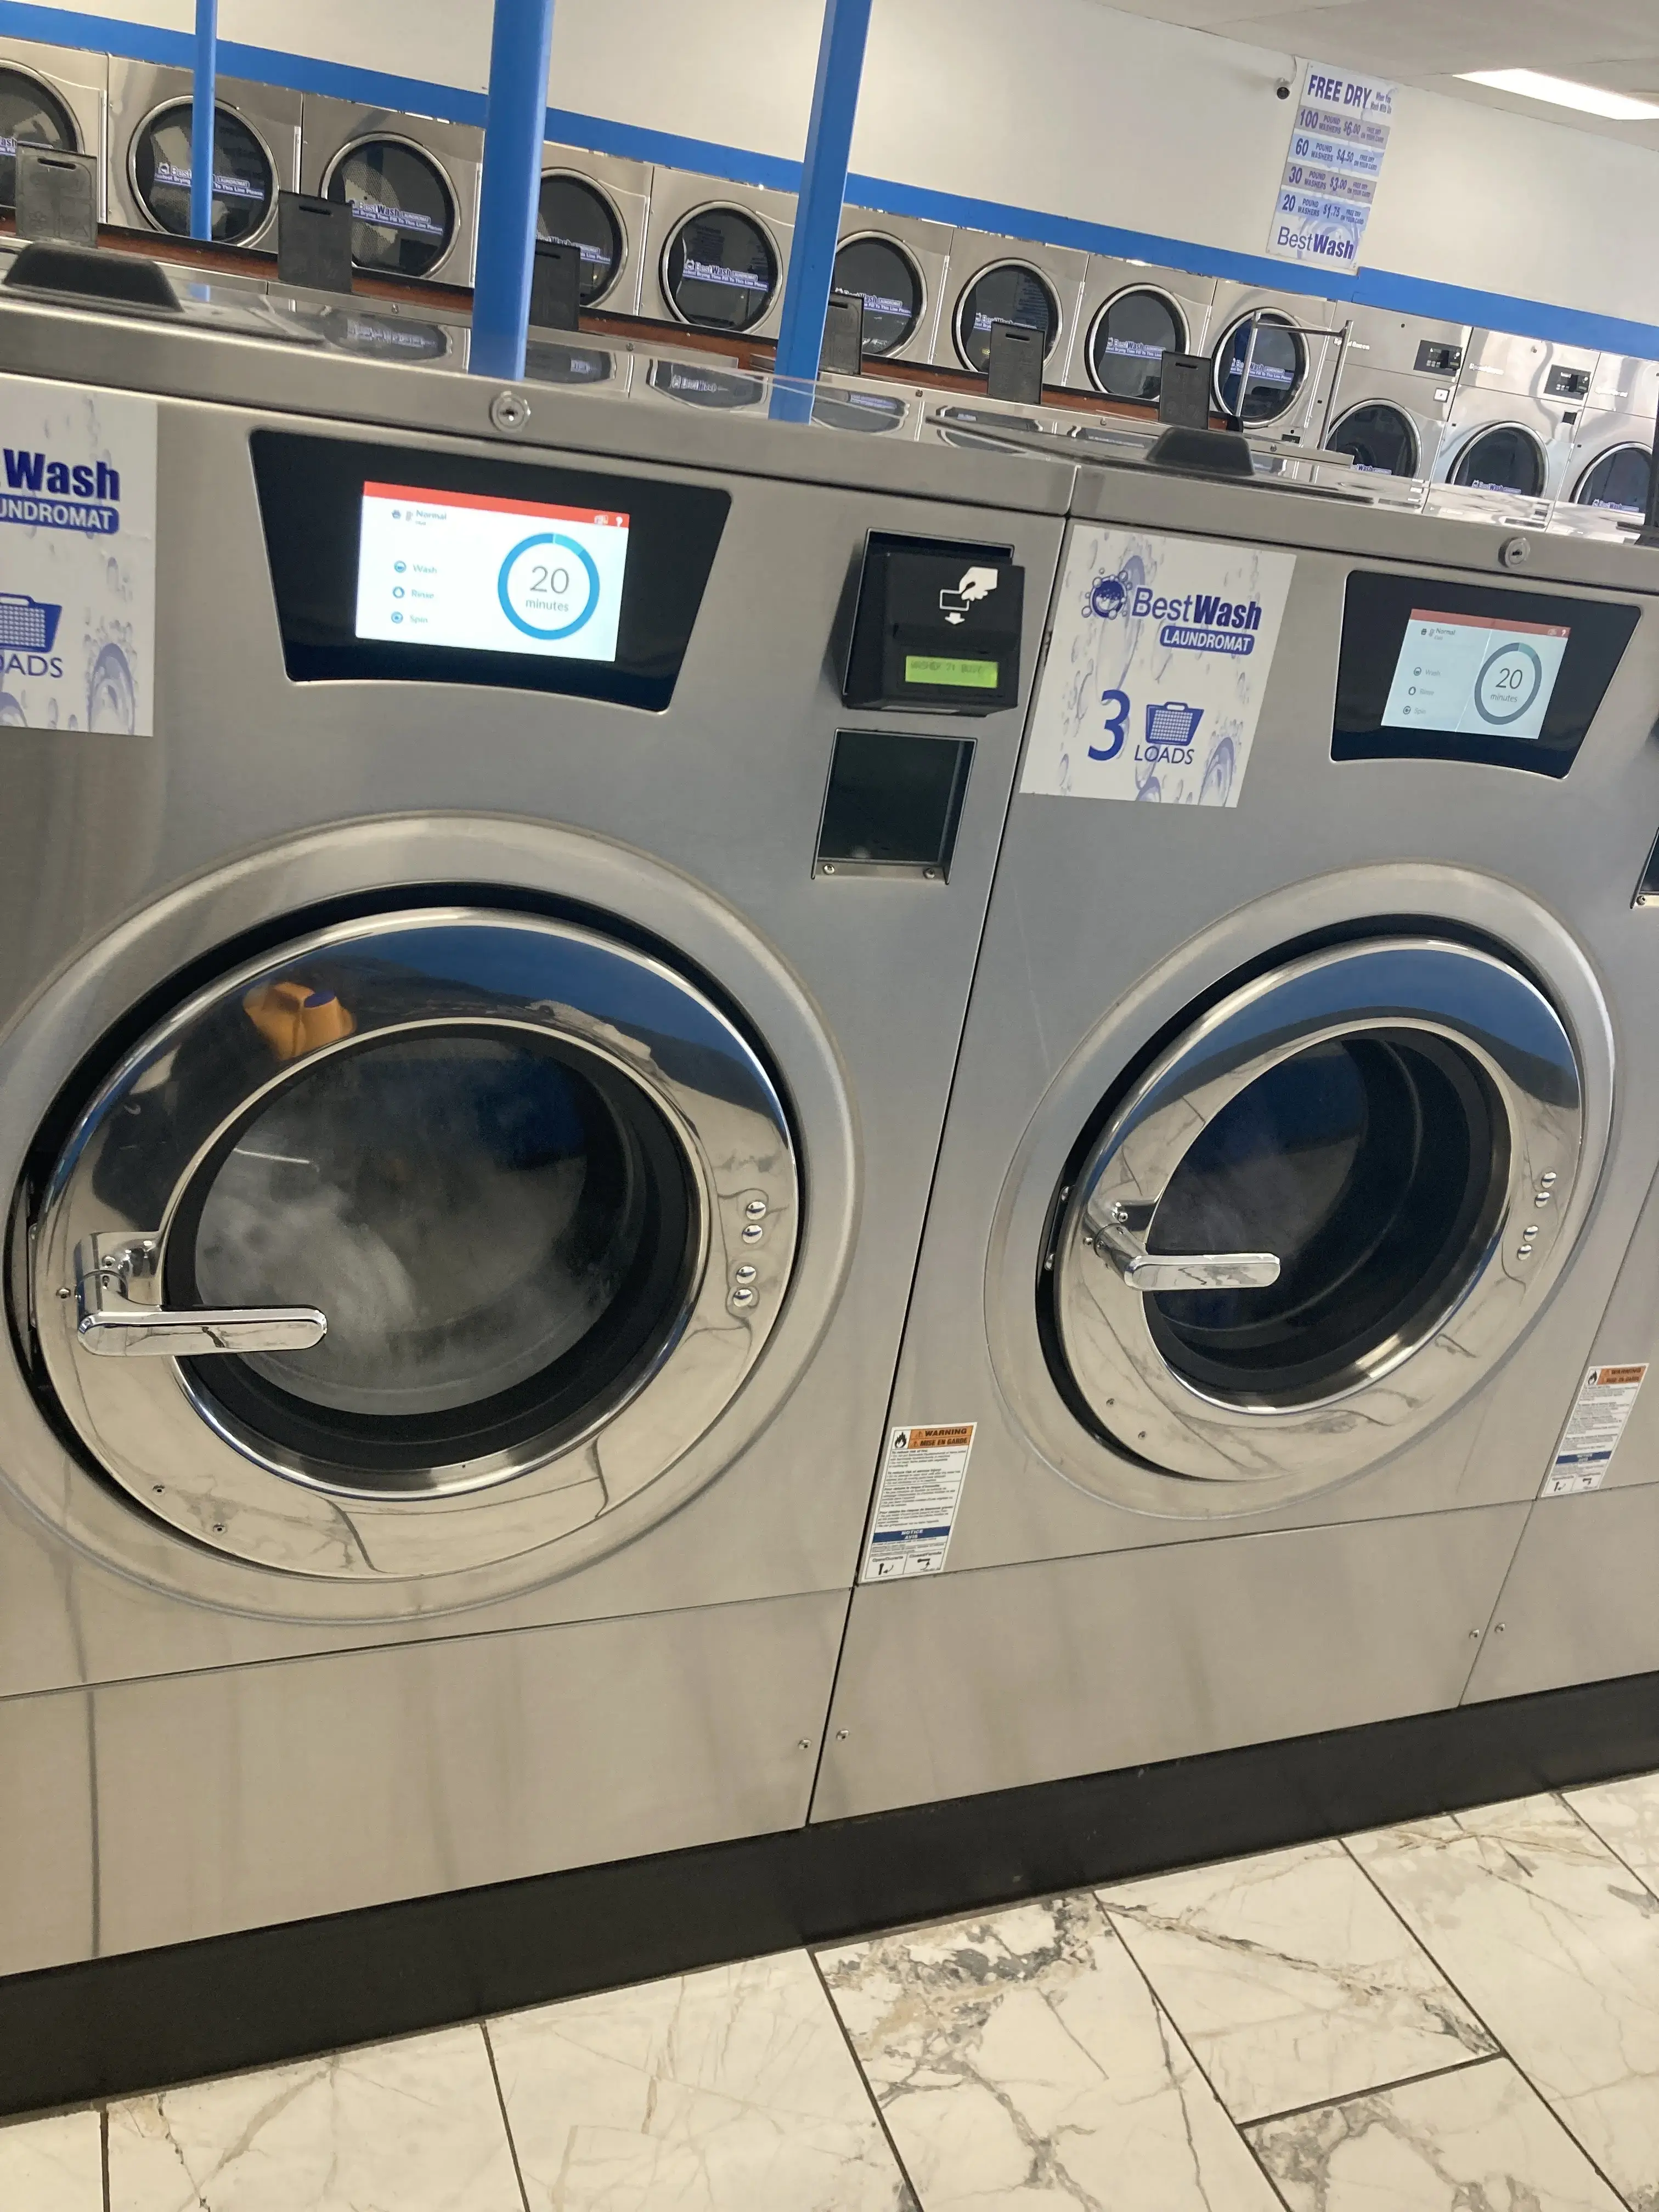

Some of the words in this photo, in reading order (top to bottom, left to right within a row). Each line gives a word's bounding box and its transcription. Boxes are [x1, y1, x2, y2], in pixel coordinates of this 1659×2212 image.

[1307, 75, 1343, 102] FREE
[1344, 84, 1372, 109] DRY
[1300, 109, 1319, 129] 100
[1323, 115, 1341, 125] POUND
[1319, 122, 1341, 134] WASHERS
[1343, 121, 1361, 136] $6.00
[1295, 138, 1309, 156] 60
[1316, 143, 1333, 153] POUND
[1311, 150, 1334, 162] WASHERS
[1336, 148, 1354, 164] $4.50
[1289, 166, 1303, 184] 30
[1308, 171, 1326, 180] POUND
[1304, 178, 1327, 190] WASHERS
[1330, 176, 1347, 191] $3.00
[1282, 194, 1296, 212] 20
[1302, 198, 1319, 208] POUND
[1297, 206, 1320, 217] WASHERS
[1323, 204, 1341, 219] $1.75
[1277, 226, 1354, 259] BestWash
[695, 262, 731, 276] BestWash
[416, 509, 447, 520] Normal
[413, 563, 438, 574] Wash
[529, 565, 569, 594] 20
[411, 589, 434, 600] Rinse
[526, 598, 569, 612] minutes
[1131, 588, 1262, 631] BestWash
[410, 614, 428, 624] Spin
[1163, 629, 1251, 652] LAUNDROMAT
[0, 653, 63, 678] ADS
[1496, 668, 1522, 690] 20
[1490, 693, 1517, 703] minutes
[1087, 689, 1131, 761] 3
[1134, 744, 1195, 765] LOADS
[925, 1428, 967, 1437] WARNING
